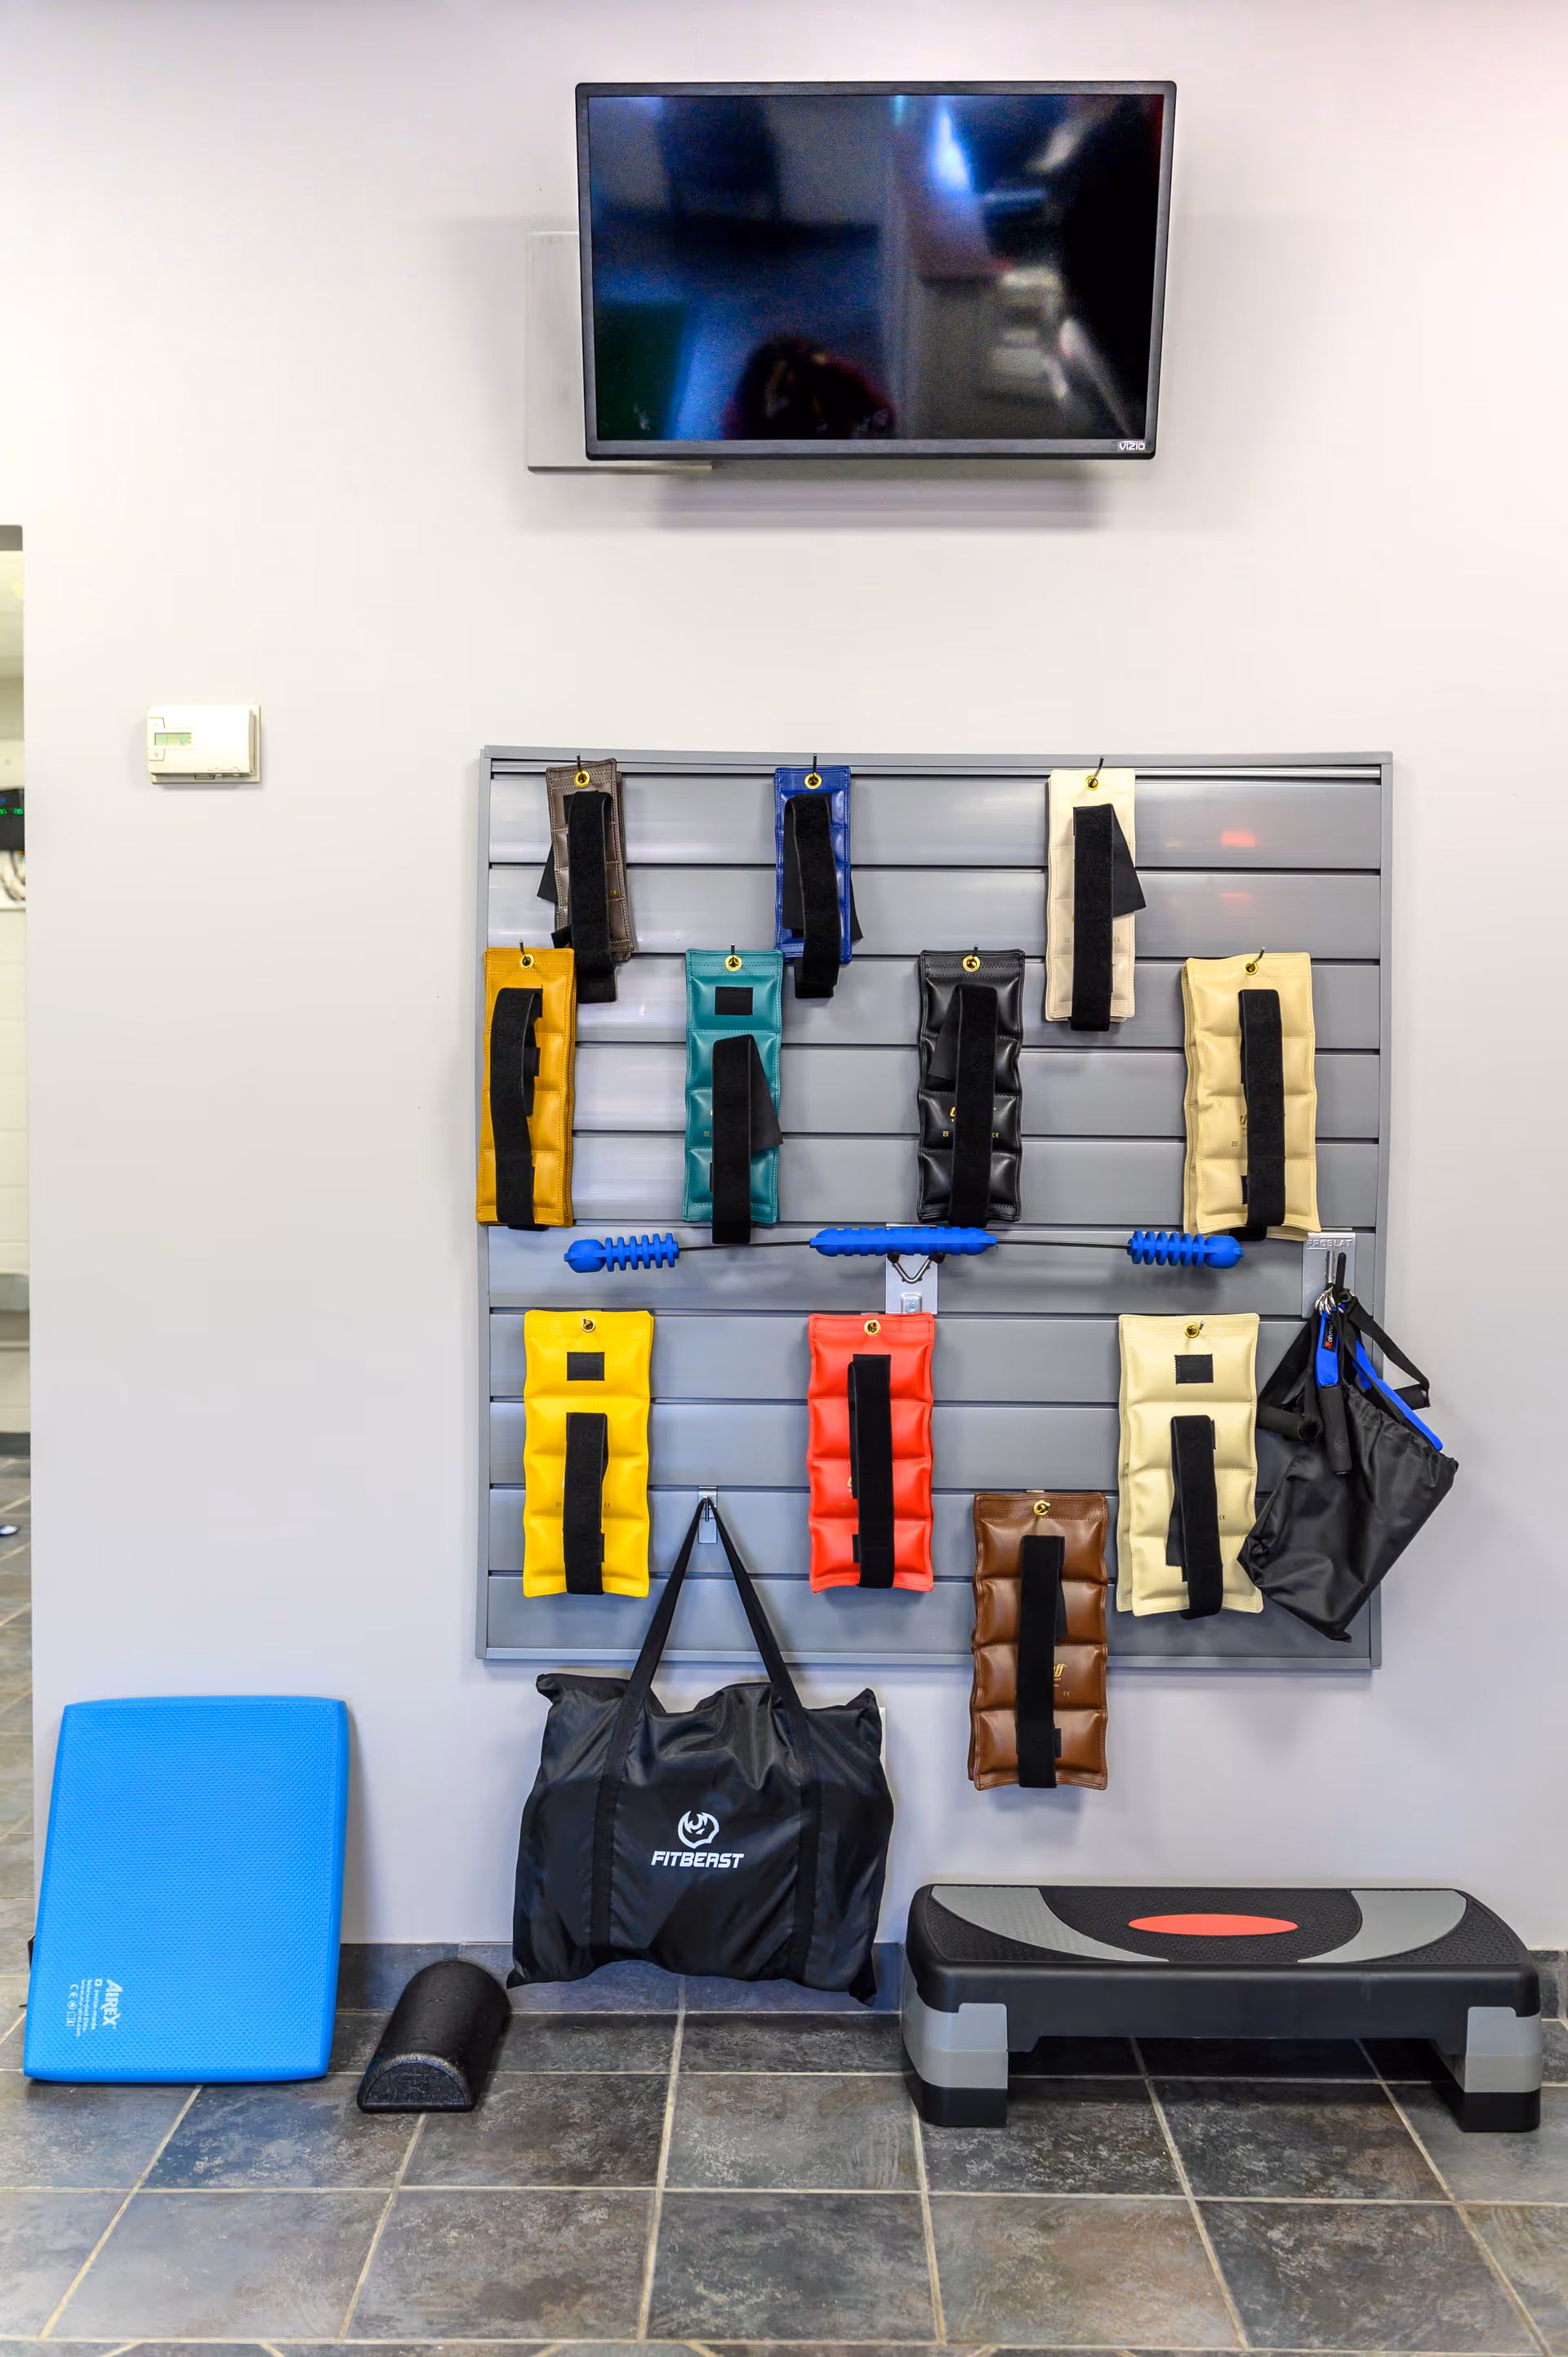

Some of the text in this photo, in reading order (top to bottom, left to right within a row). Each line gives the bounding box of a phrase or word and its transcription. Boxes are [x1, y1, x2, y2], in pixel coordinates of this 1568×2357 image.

[1119, 442, 1146, 451] VIZIO
[651, 1850, 745, 1869] FITBEAST
[100, 1979, 123, 2026] AIREX
